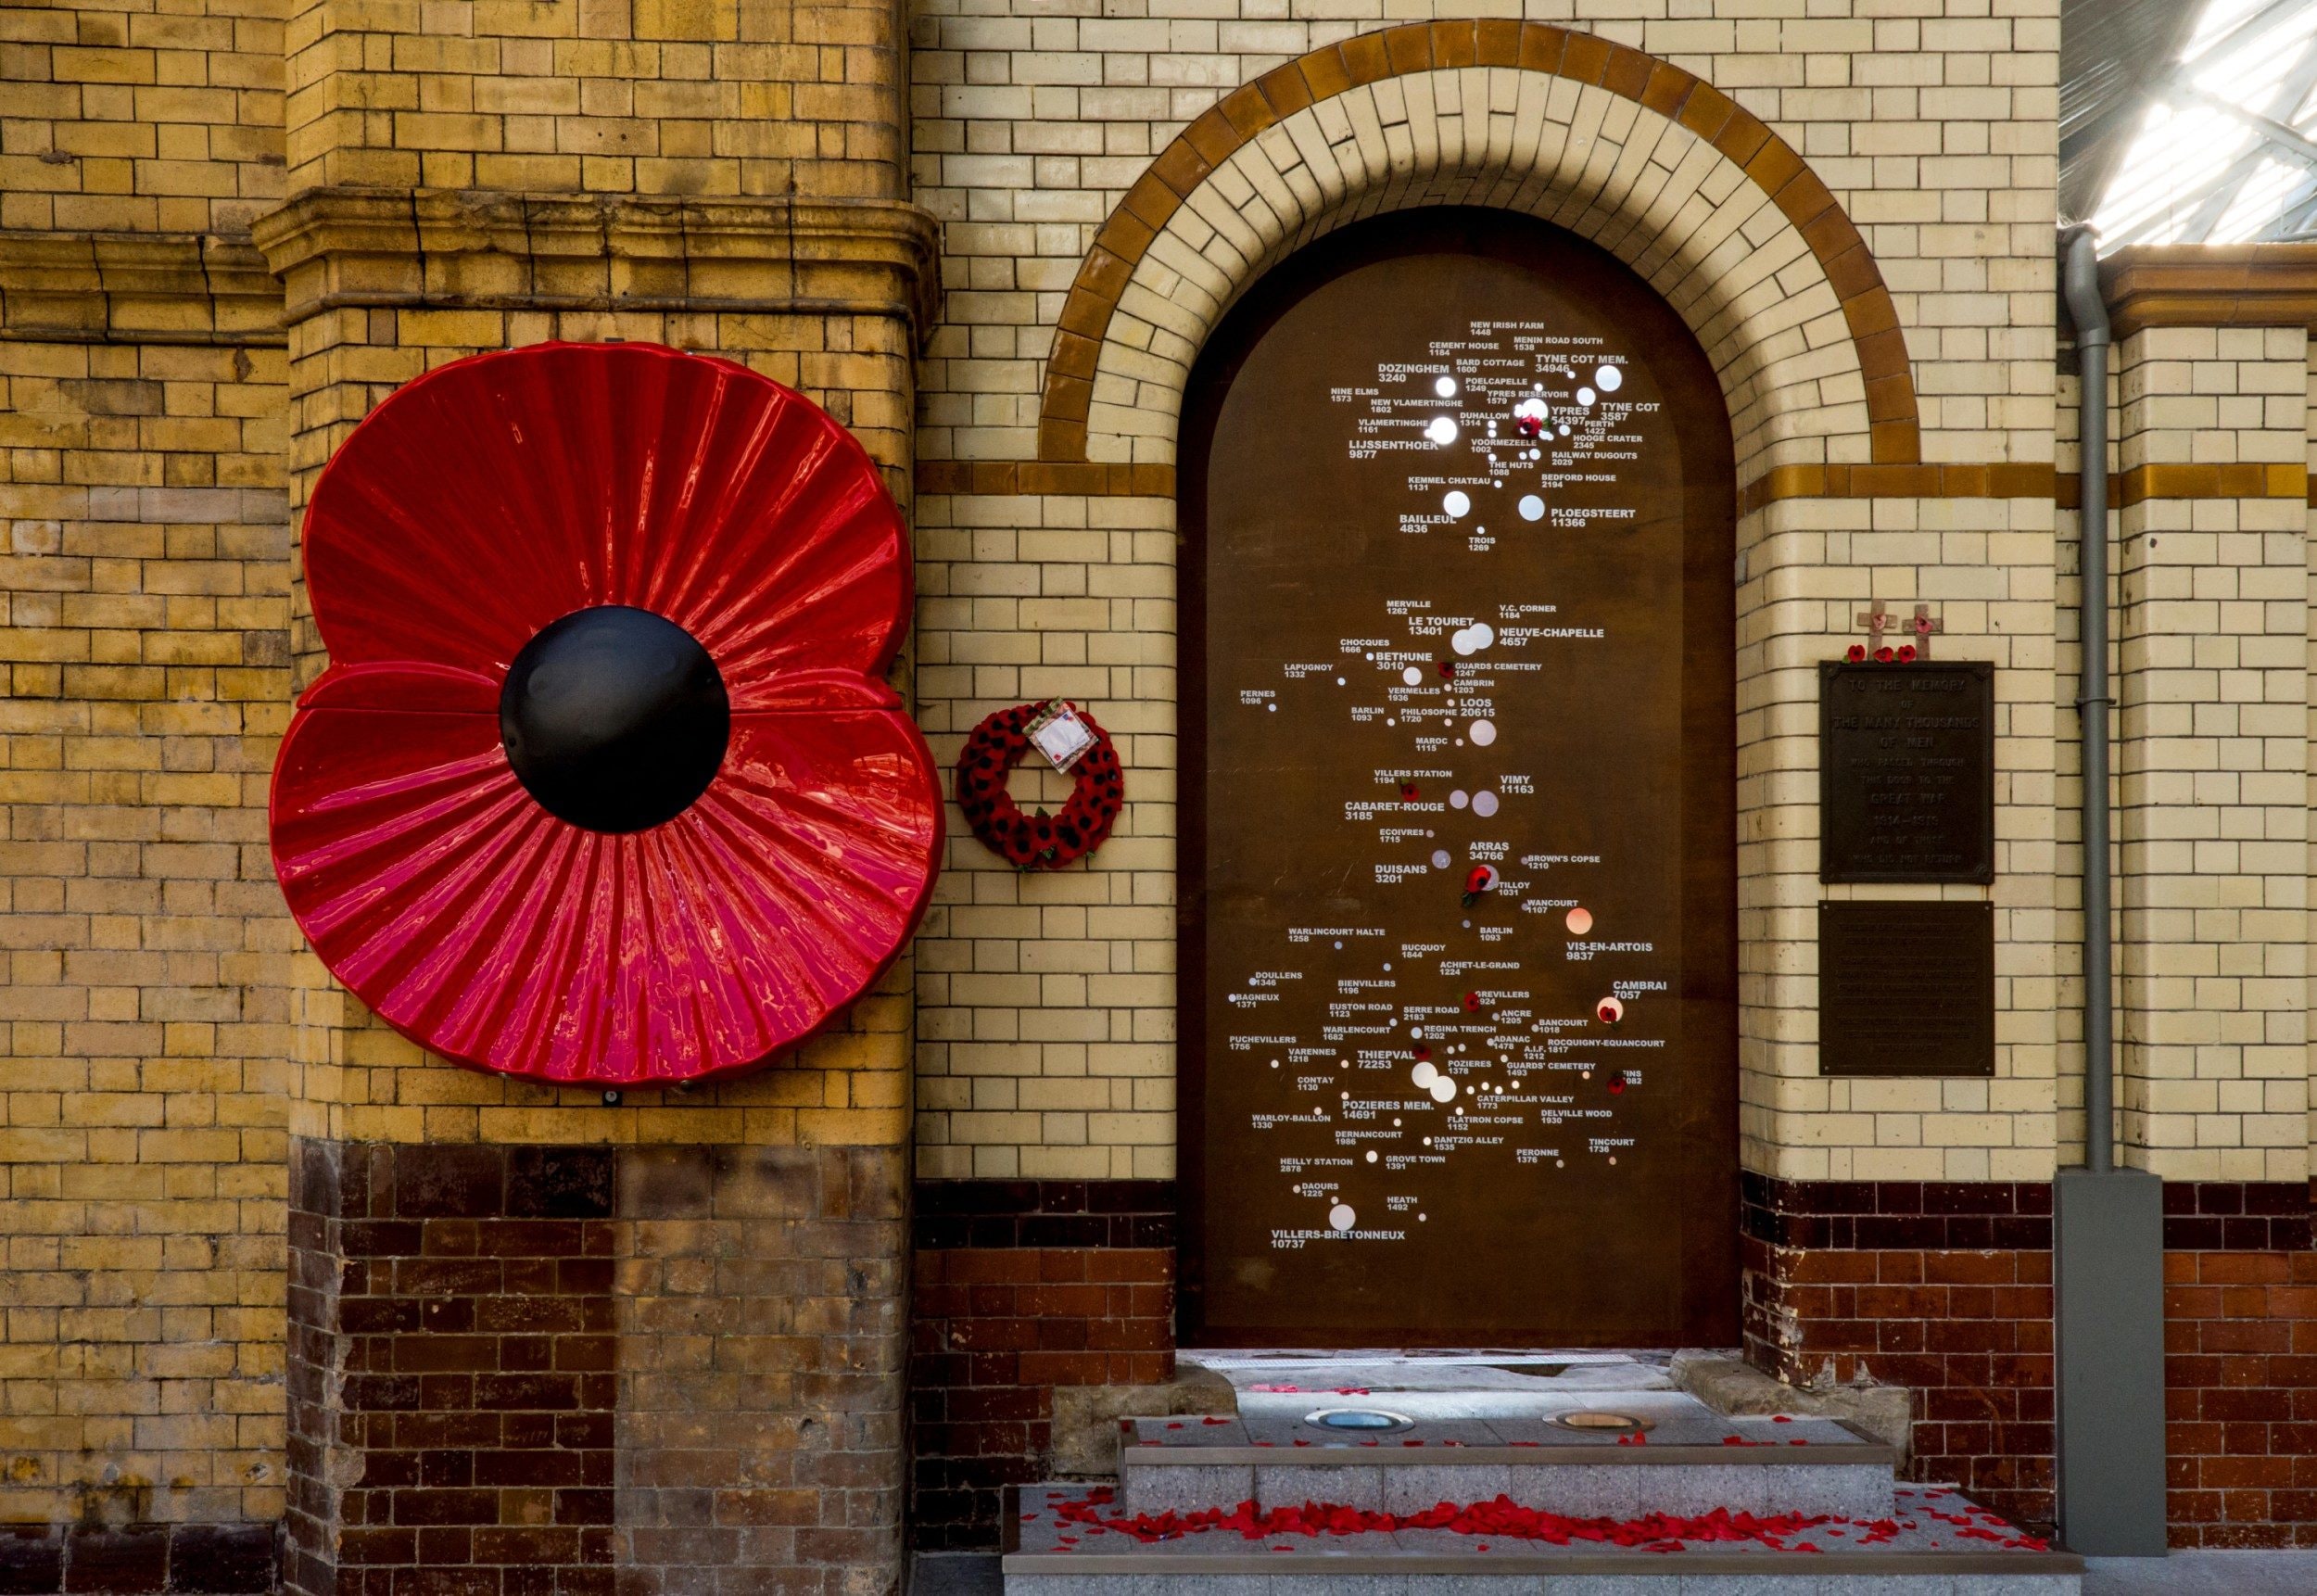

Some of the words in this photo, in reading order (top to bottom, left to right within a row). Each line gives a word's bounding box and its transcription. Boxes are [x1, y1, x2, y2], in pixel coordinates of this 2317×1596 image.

[1536, 355, 1567, 363] TYNE
[1571, 355, 1595, 363] COT
[1598, 356, 1628, 364] MEM.
[1379, 364, 1449, 373] DOZINGHEM
[1536, 364, 1570, 373] 34946
[1379, 374, 1406, 382] 3240
[1552, 407, 1589, 415] YPRES
[1601, 403, 1632, 411] TYNE
[1636, 403, 1660, 411] COT
[1551, 416, 1585, 425] 54397
[1601, 412, 1628, 421] 3587
[1349, 440, 1439, 450] LIJSSENTHOEK
[1349, 450, 1377, 458] 9877
[1551, 509, 1635, 518] PLOEGSTEERT
[1400, 515, 1457, 524] BAILLEUL
[1551, 518, 1586, 527] 11366
[1400, 524, 1427, 533] 4836
[1409, 617, 1423, 625] LE
[1427, 617, 1475, 626] TOURET
[1409, 626, 1442, 635] 13401
[1500, 628, 1604, 637] NEUVE-CHAPELLE
[1500, 638, 1528, 646] 4657
[1376, 652, 1432, 661] BETHUNE
[1377, 662, 1404, 670] 3010
[1460, 699, 1491, 707] LOOS
[1461, 708, 1495, 717] 20615
[1501, 775, 1530, 784] VIMY
[1500, 785, 1534, 793] 11163
[1345, 802, 1444, 811] CABARET-ROUGE
[1345, 812, 1372, 820] 3185
[1470, 842, 1509, 851] ARRAS
[1470, 851, 1504, 860] 34766
[1375, 865, 1427, 873] DUISANS
[1376, 874, 1402, 883] 3201
[1567, 942, 1652, 951] VIS-EN-ARTOIS
[1567, 952, 1593, 960] 9837
[1613, 981, 1666, 990] CAMBRAI
[1613, 991, 1641, 999] 7057
[1358, 1051, 1415, 1059] THIEPVAL
[1358, 1060, 1391, 1068] 72253
[1343, 1101, 1400, 1109] POZIERES
[1404, 1102, 1434, 1110] MEM.
[1343, 1111, 1376, 1119] 14691
[1272, 1230, 1405, 1239] VILLERS-BRETONNEUX
[1271, 1239, 1305, 1248] 10737
